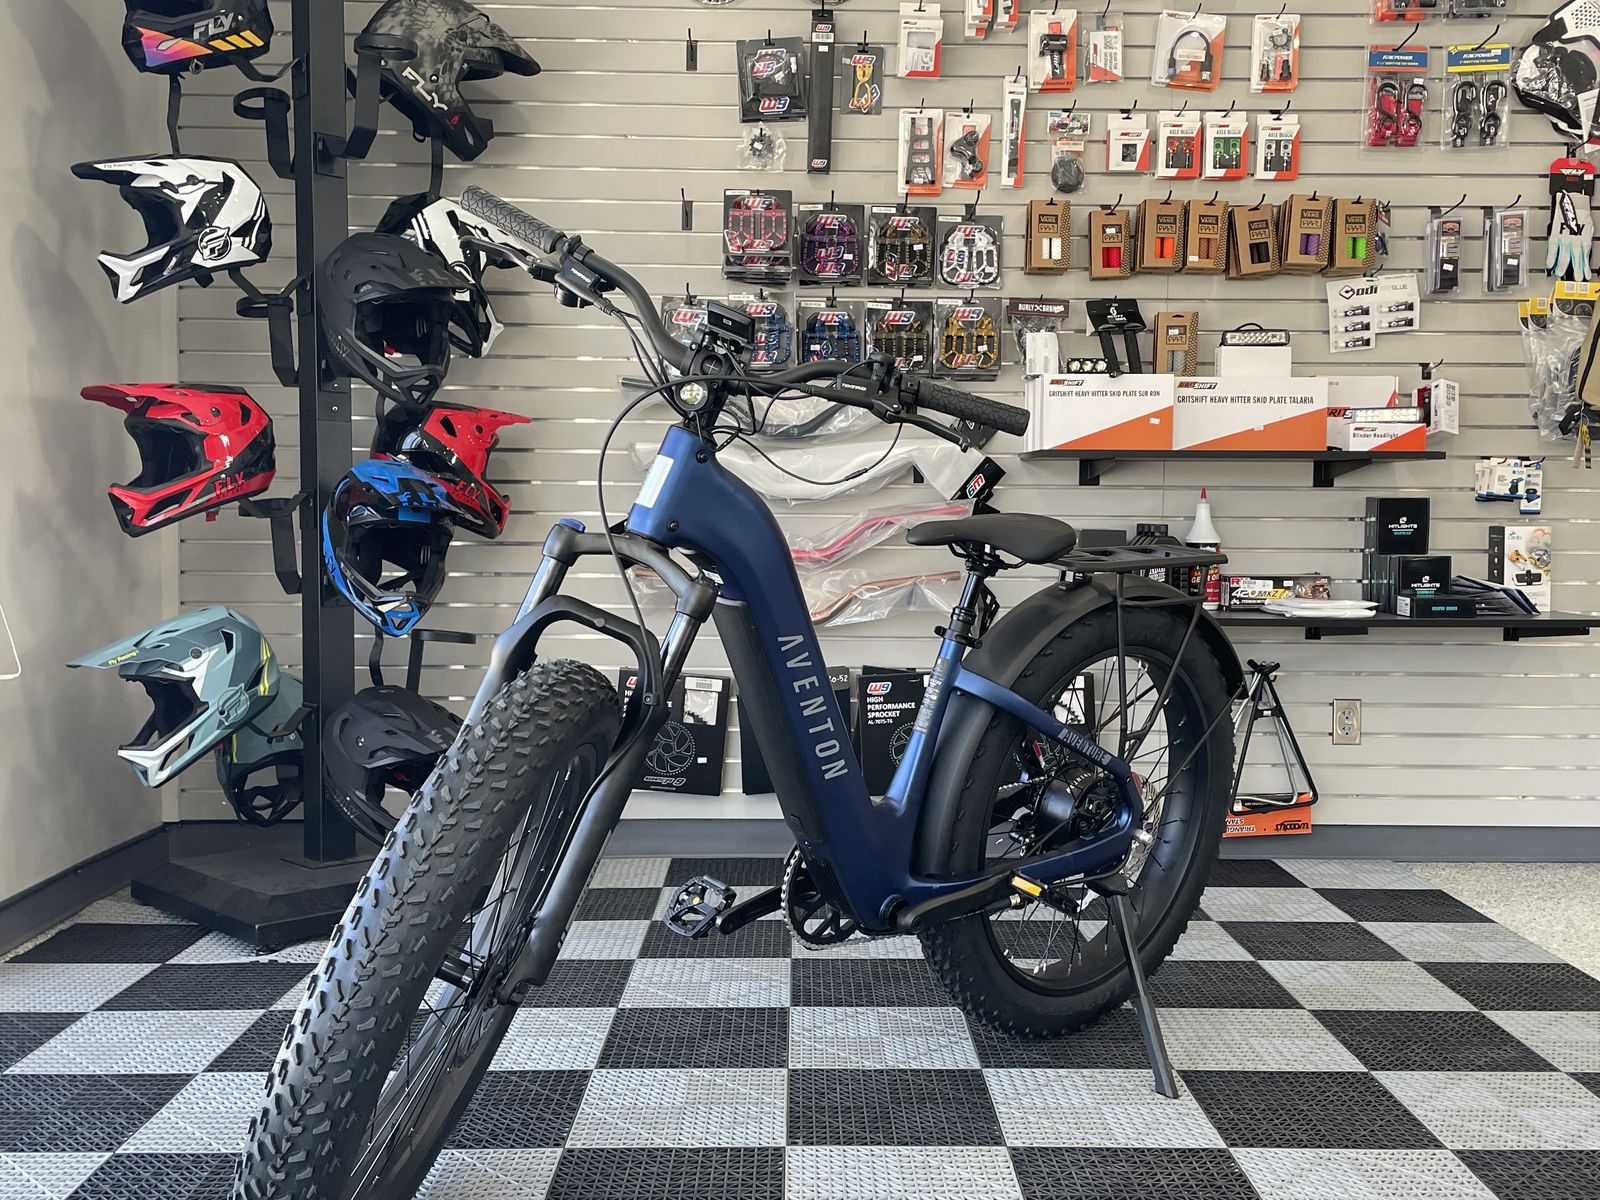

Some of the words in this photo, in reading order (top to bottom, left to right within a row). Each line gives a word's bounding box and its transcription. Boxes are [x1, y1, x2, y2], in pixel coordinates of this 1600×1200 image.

[193, 12, 234, 40] FLY
[851, 55, 876, 65] W9
[402, 66, 448, 111] FLY
[760, 96, 790, 111] W9
[744, 198, 774, 210] W9
[1356, 285, 1377, 296] odi
[747, 303, 776, 316] W9
[954, 307, 984, 321] W9
[884, 311, 915, 324] W9
[215, 471, 244, 495] FLY
[455, 480, 480, 500] FLY
[966, 474, 985, 498] W9
[117, 650, 136, 662] Racing
[867, 682, 892, 694] W9
[777, 634, 848, 780] AVENTON
[867, 702, 915, 710] PERFORMANCE
[1063, 732, 1108, 763] AVENTURE
